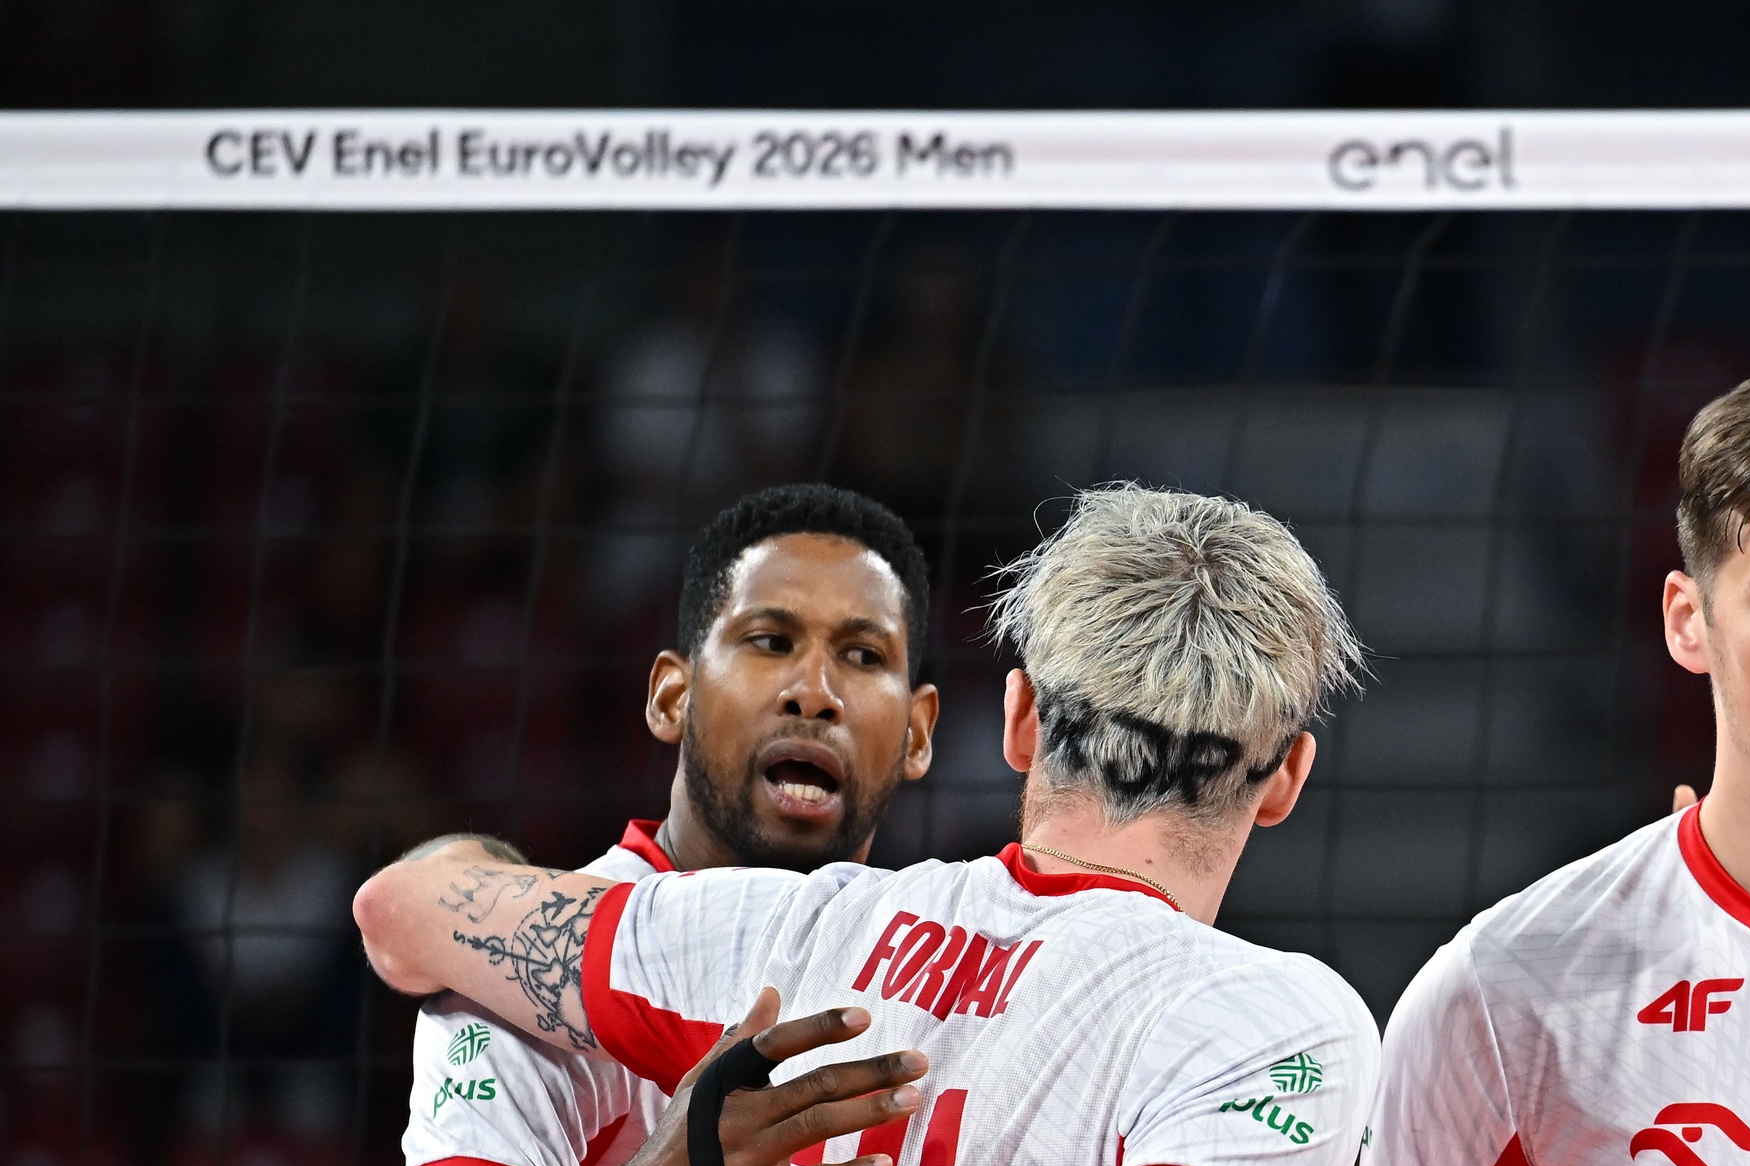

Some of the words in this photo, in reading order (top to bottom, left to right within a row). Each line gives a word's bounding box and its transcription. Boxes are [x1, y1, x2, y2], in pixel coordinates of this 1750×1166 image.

[206, 129, 317, 178] CEV
[332, 128, 440, 178] Enel
[457, 129, 737, 189] EuroVolley
[752, 130, 879, 178] 2026
[898, 130, 1016, 178] Men
[1327, 125, 1516, 190] enel
[851, 910, 1045, 1022] FORNAL
[1636, 977, 1745, 1032] 4F
